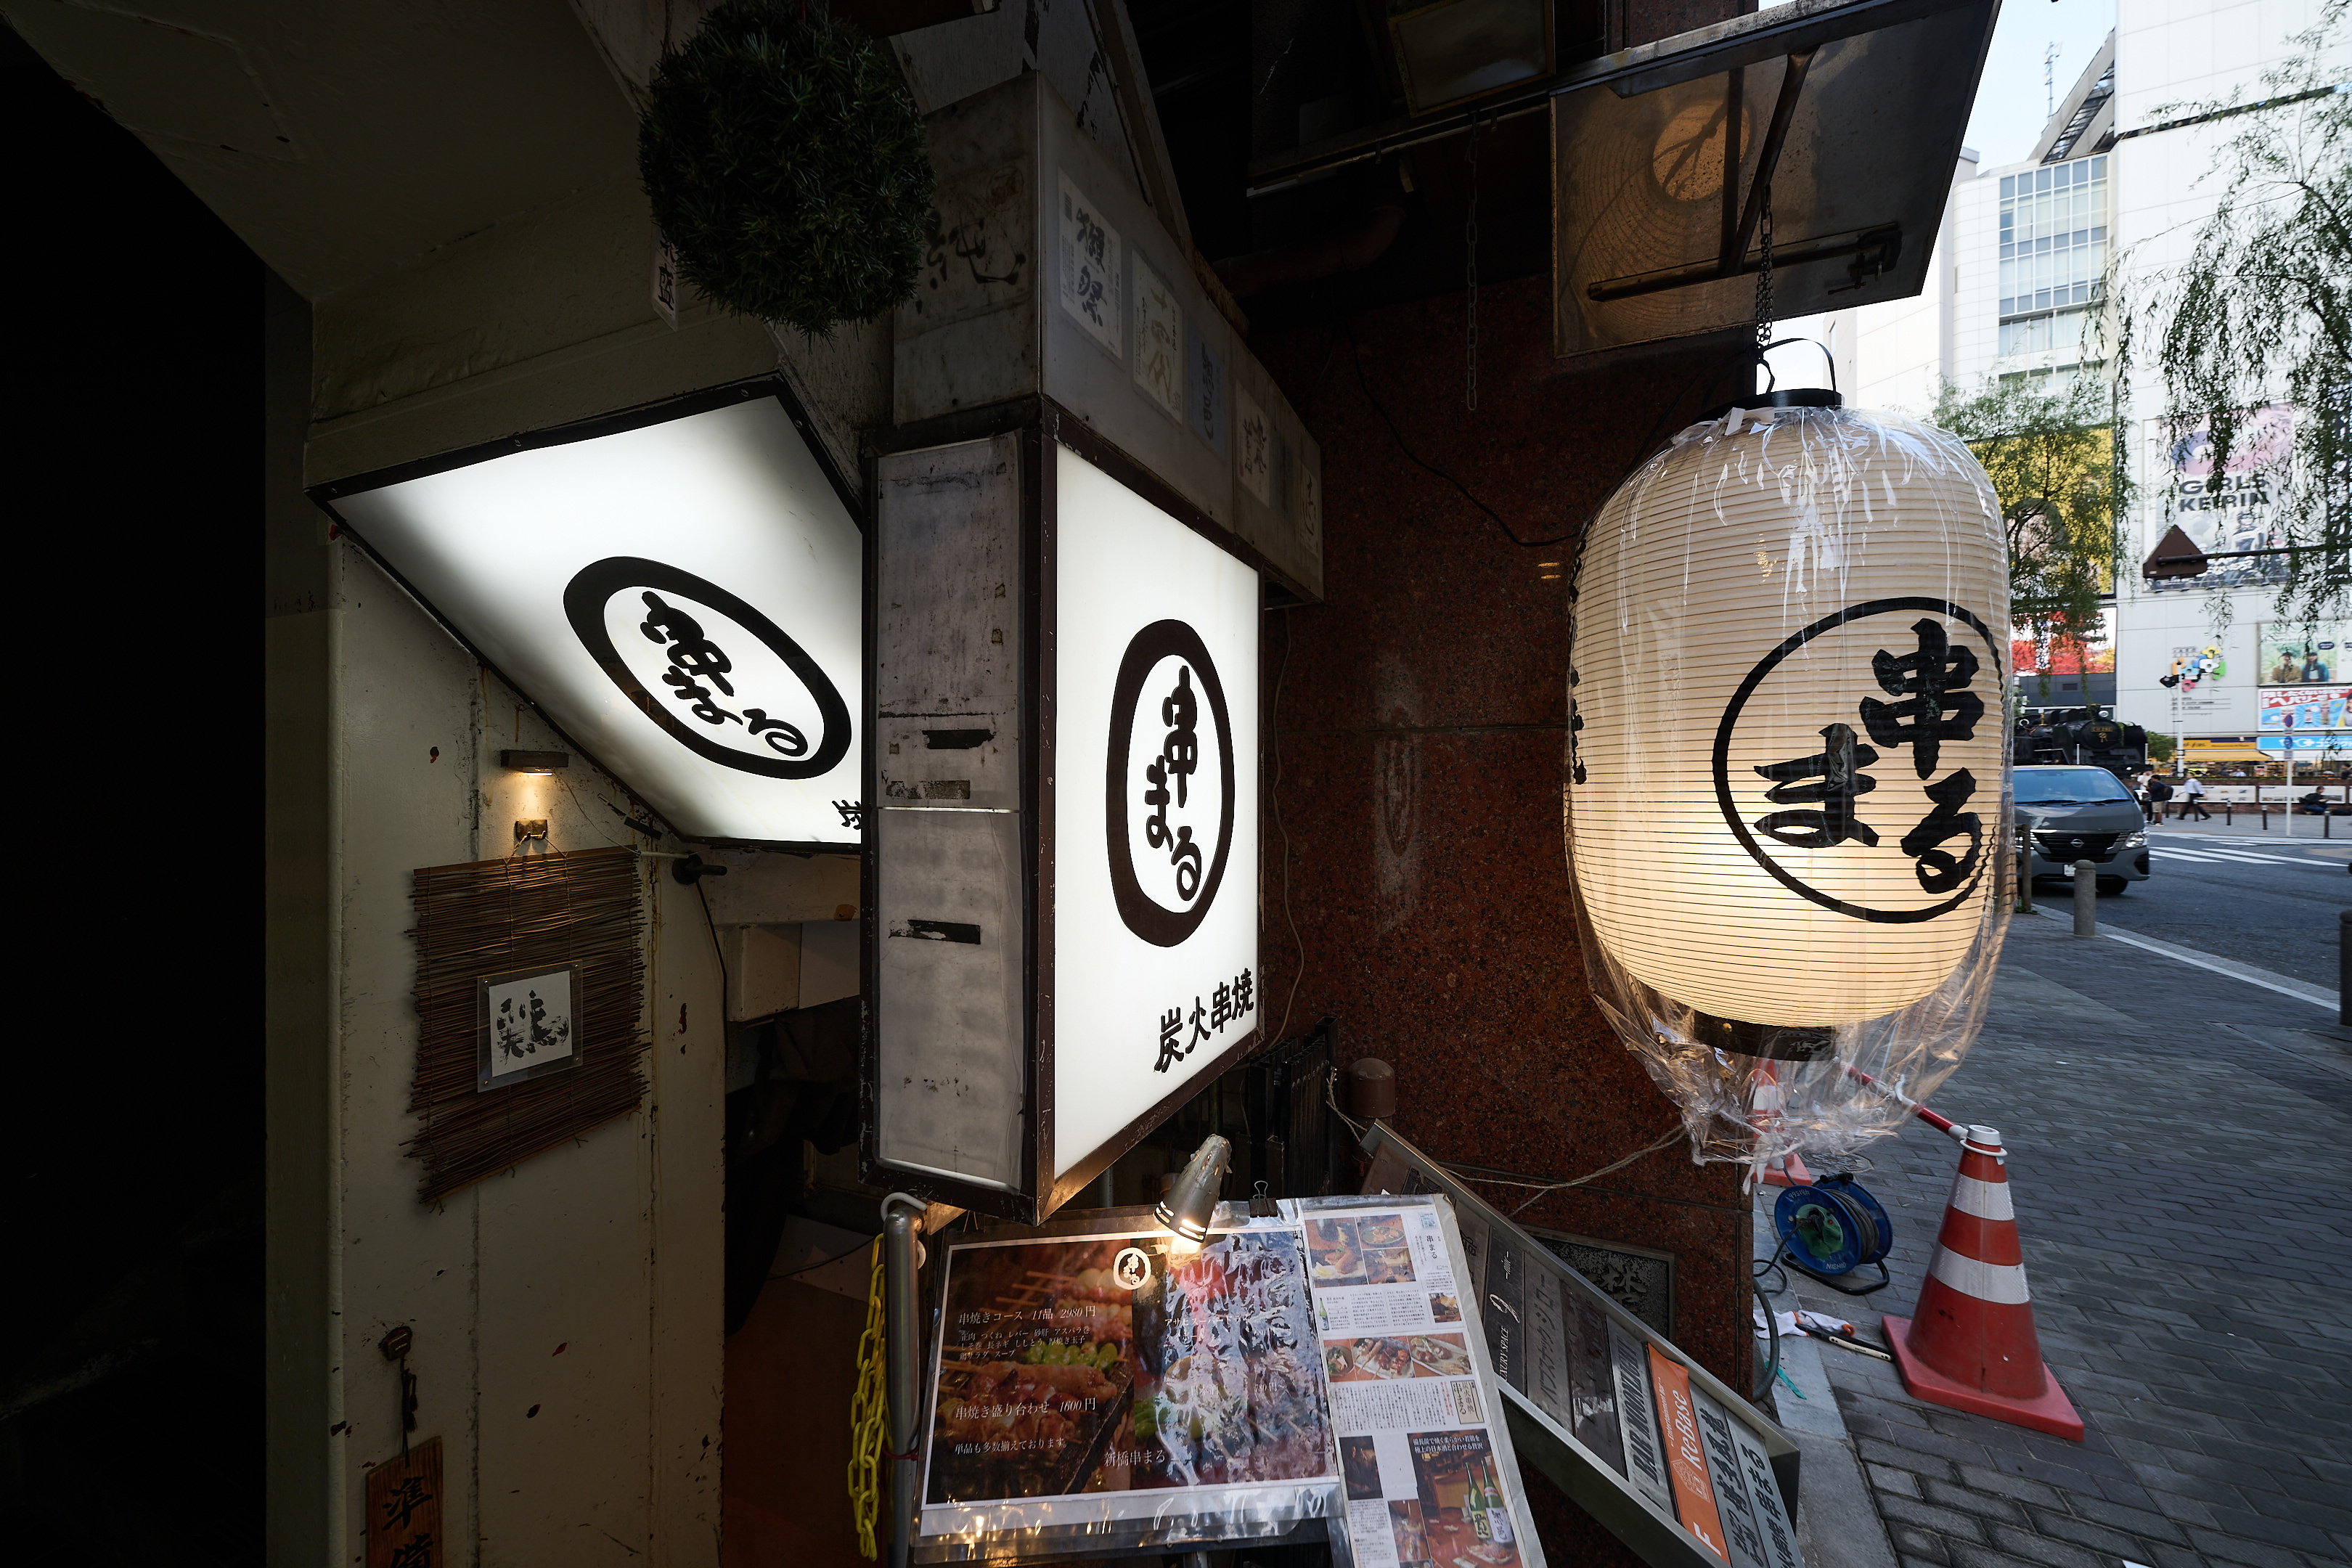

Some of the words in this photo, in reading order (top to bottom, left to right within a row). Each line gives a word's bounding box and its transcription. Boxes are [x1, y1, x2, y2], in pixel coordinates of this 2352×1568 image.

[2180, 473, 2266, 495] GRLS
[2180, 491, 2270, 513] KERIN
[640, 590, 809, 757] 串まる
[1754, 617, 1985, 894] 串まる
[1144, 665, 1202, 902] 串まる
[1153, 968, 1254, 1073] 炭火串焼
[1426, 1235, 1437, 1259] 串まる
[1122, 1253, 1141, 1286] 串まる
[1826, 1262, 1847, 1270] NISHIO
[959, 1310, 1024, 1325] 串焼きコース
[1032, 1307, 1053, 1321] 11品
[1060, 1304, 1096, 1319] 2980円
[960, 1332, 976, 1342] 正肉
[981, 1331, 1003, 1341] つくね
[1008, 1330, 1029, 1339] レバー
[1034, 1328, 1049, 1338] 砂肝
[1054, 1326, 1090, 1336] アスパラ巻
[960, 1341, 982, 1352] しそ巻
[987, 1339, 1009, 1349] 長ネギ
[1016, 1337, 1044, 1348] ししとう
[1048, 1334, 1086, 1346] 厚焼き玉子
[1500, 1325, 1509, 1354] SPACE
[1536, 1274, 1559, 1405] パブスナックジロー
[959, 1350, 989, 1361] 鶏サラダ
[994, 1349, 1016, 1359] スープ
[1499, 1354, 1509, 1382] UXURY
[1453, 1382, 1466, 1415] 串まる
[1616, 1334, 1651, 1441] MOONLIGHT
[955, 1401, 1050, 1421] 串焼き盛り合わせ
[1661, 1397, 1675, 1441] Entertainment
[1672, 1389, 1703, 1471] ReBase
[955, 1437, 1068, 1455] 単品も多数揃えております。
[1104, 1449, 1166, 1467] 新橋串まる
[1630, 1433, 1660, 1487] BAR
[1741, 1443, 1781, 1522] 串まる
[1766, 1516, 1796, 1568] 火串焼
